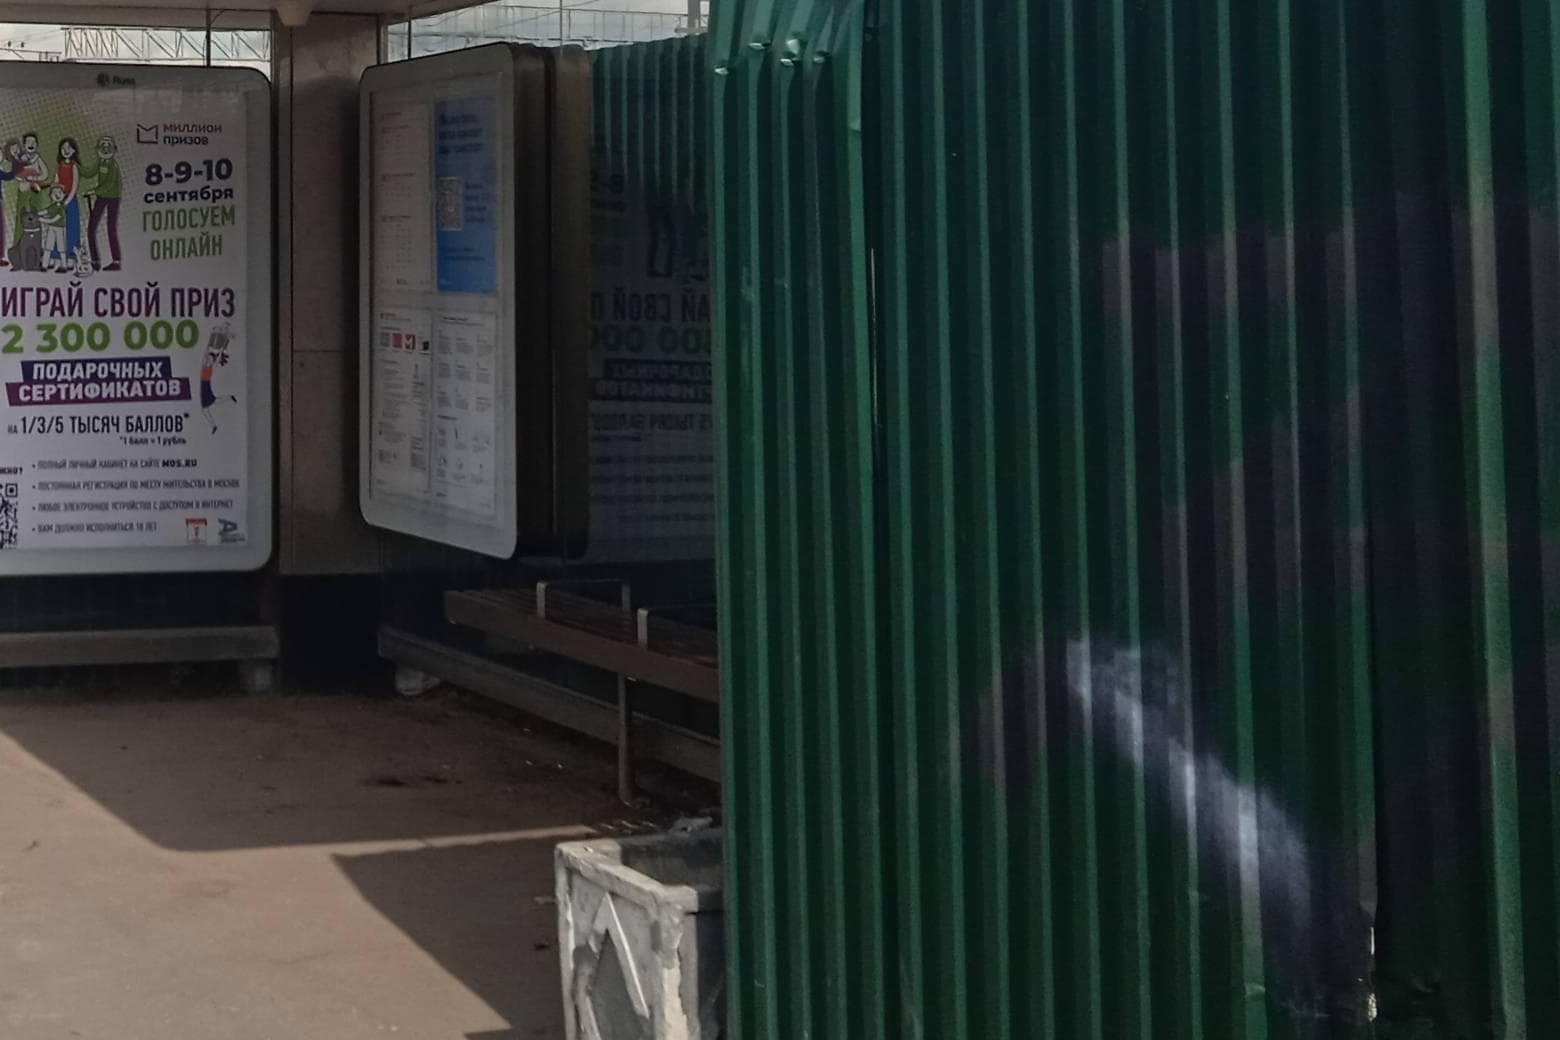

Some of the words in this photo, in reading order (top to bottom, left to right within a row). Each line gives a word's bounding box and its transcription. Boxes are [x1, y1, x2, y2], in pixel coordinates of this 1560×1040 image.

[163, 123, 222, 133] миллион
[163, 135, 209, 147] призов
[145, 158, 233, 186] 8-9-10
[144, 185, 234, 204] сентября
[143, 204, 236, 232] ГОЛОСУЕМ
[151, 231, 223, 261] ОНЛАЙН
[94, 280, 160, 318] СВОЙ
[171, 287, 235, 318] ПРИЗ
[1, 323, 24, 354] 2
[35, 321, 111, 353] 300
[124, 319, 200, 350] 000
[32, 361, 163, 382] ПОДАРОЧНЫХ
[18, 379, 182, 402] СЕРТИФИКАТОВ
[21, 415, 64, 434] 1/3/5
[69, 415, 120, 434] ТЫСЯЧ
